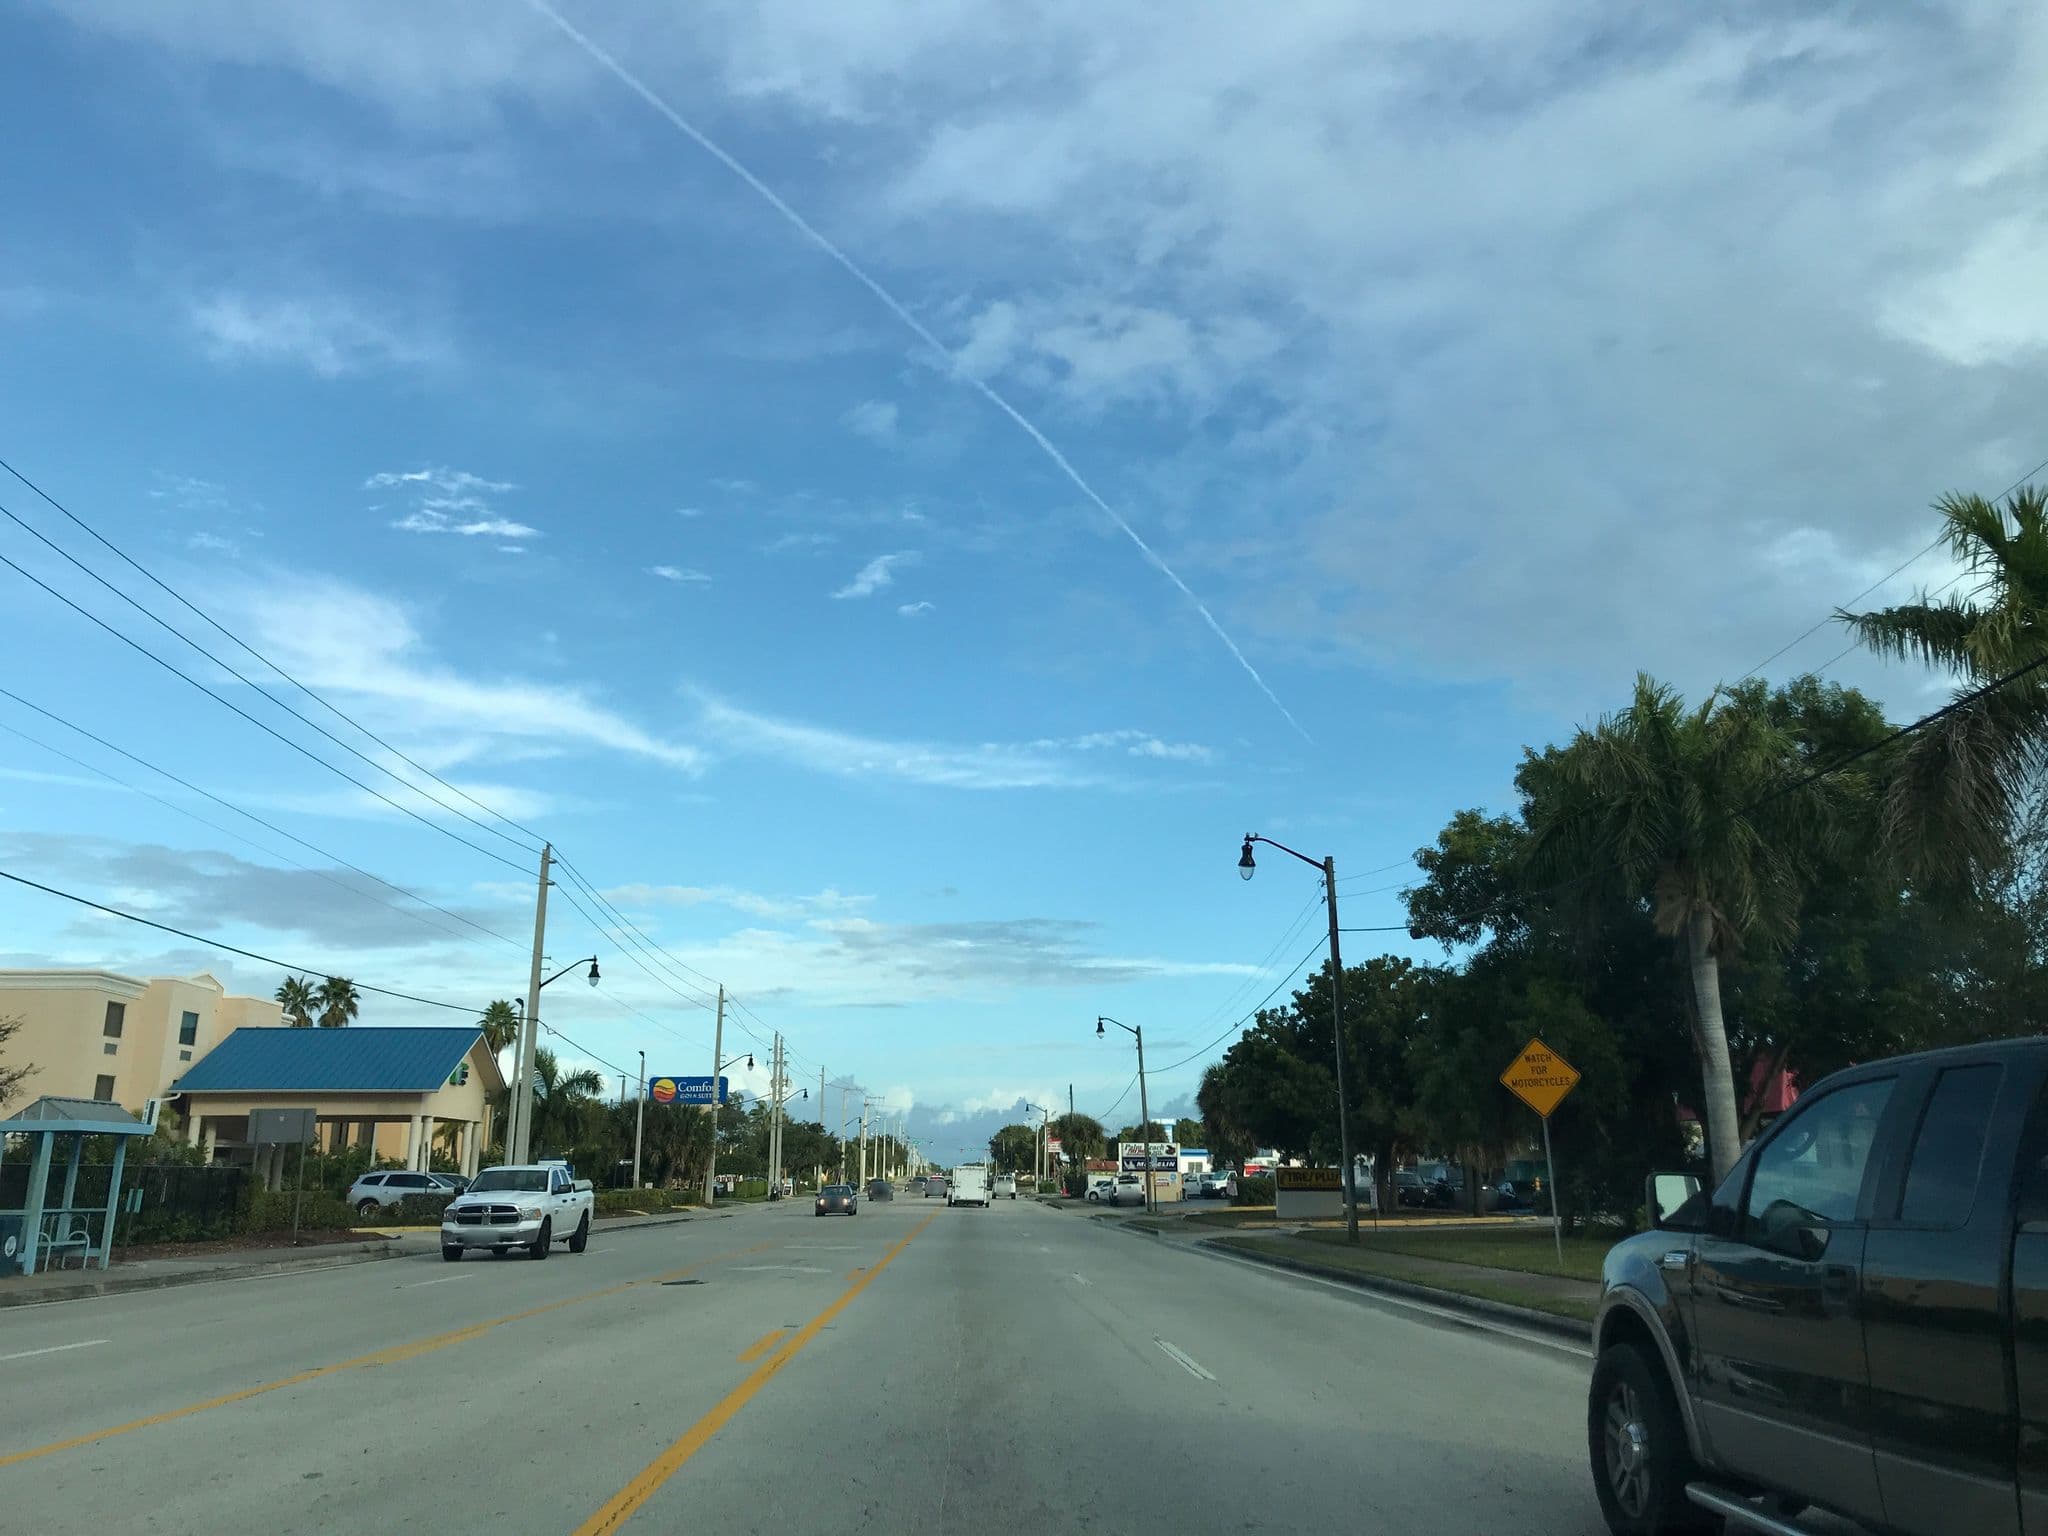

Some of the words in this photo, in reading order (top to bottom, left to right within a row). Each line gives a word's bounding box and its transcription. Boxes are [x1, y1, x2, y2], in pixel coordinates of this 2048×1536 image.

[1524, 1053, 1551, 1063] WATCH
[1531, 1066, 1547, 1075] FOR
[1511, 1077, 1570, 1088] MOTORCYCLES
